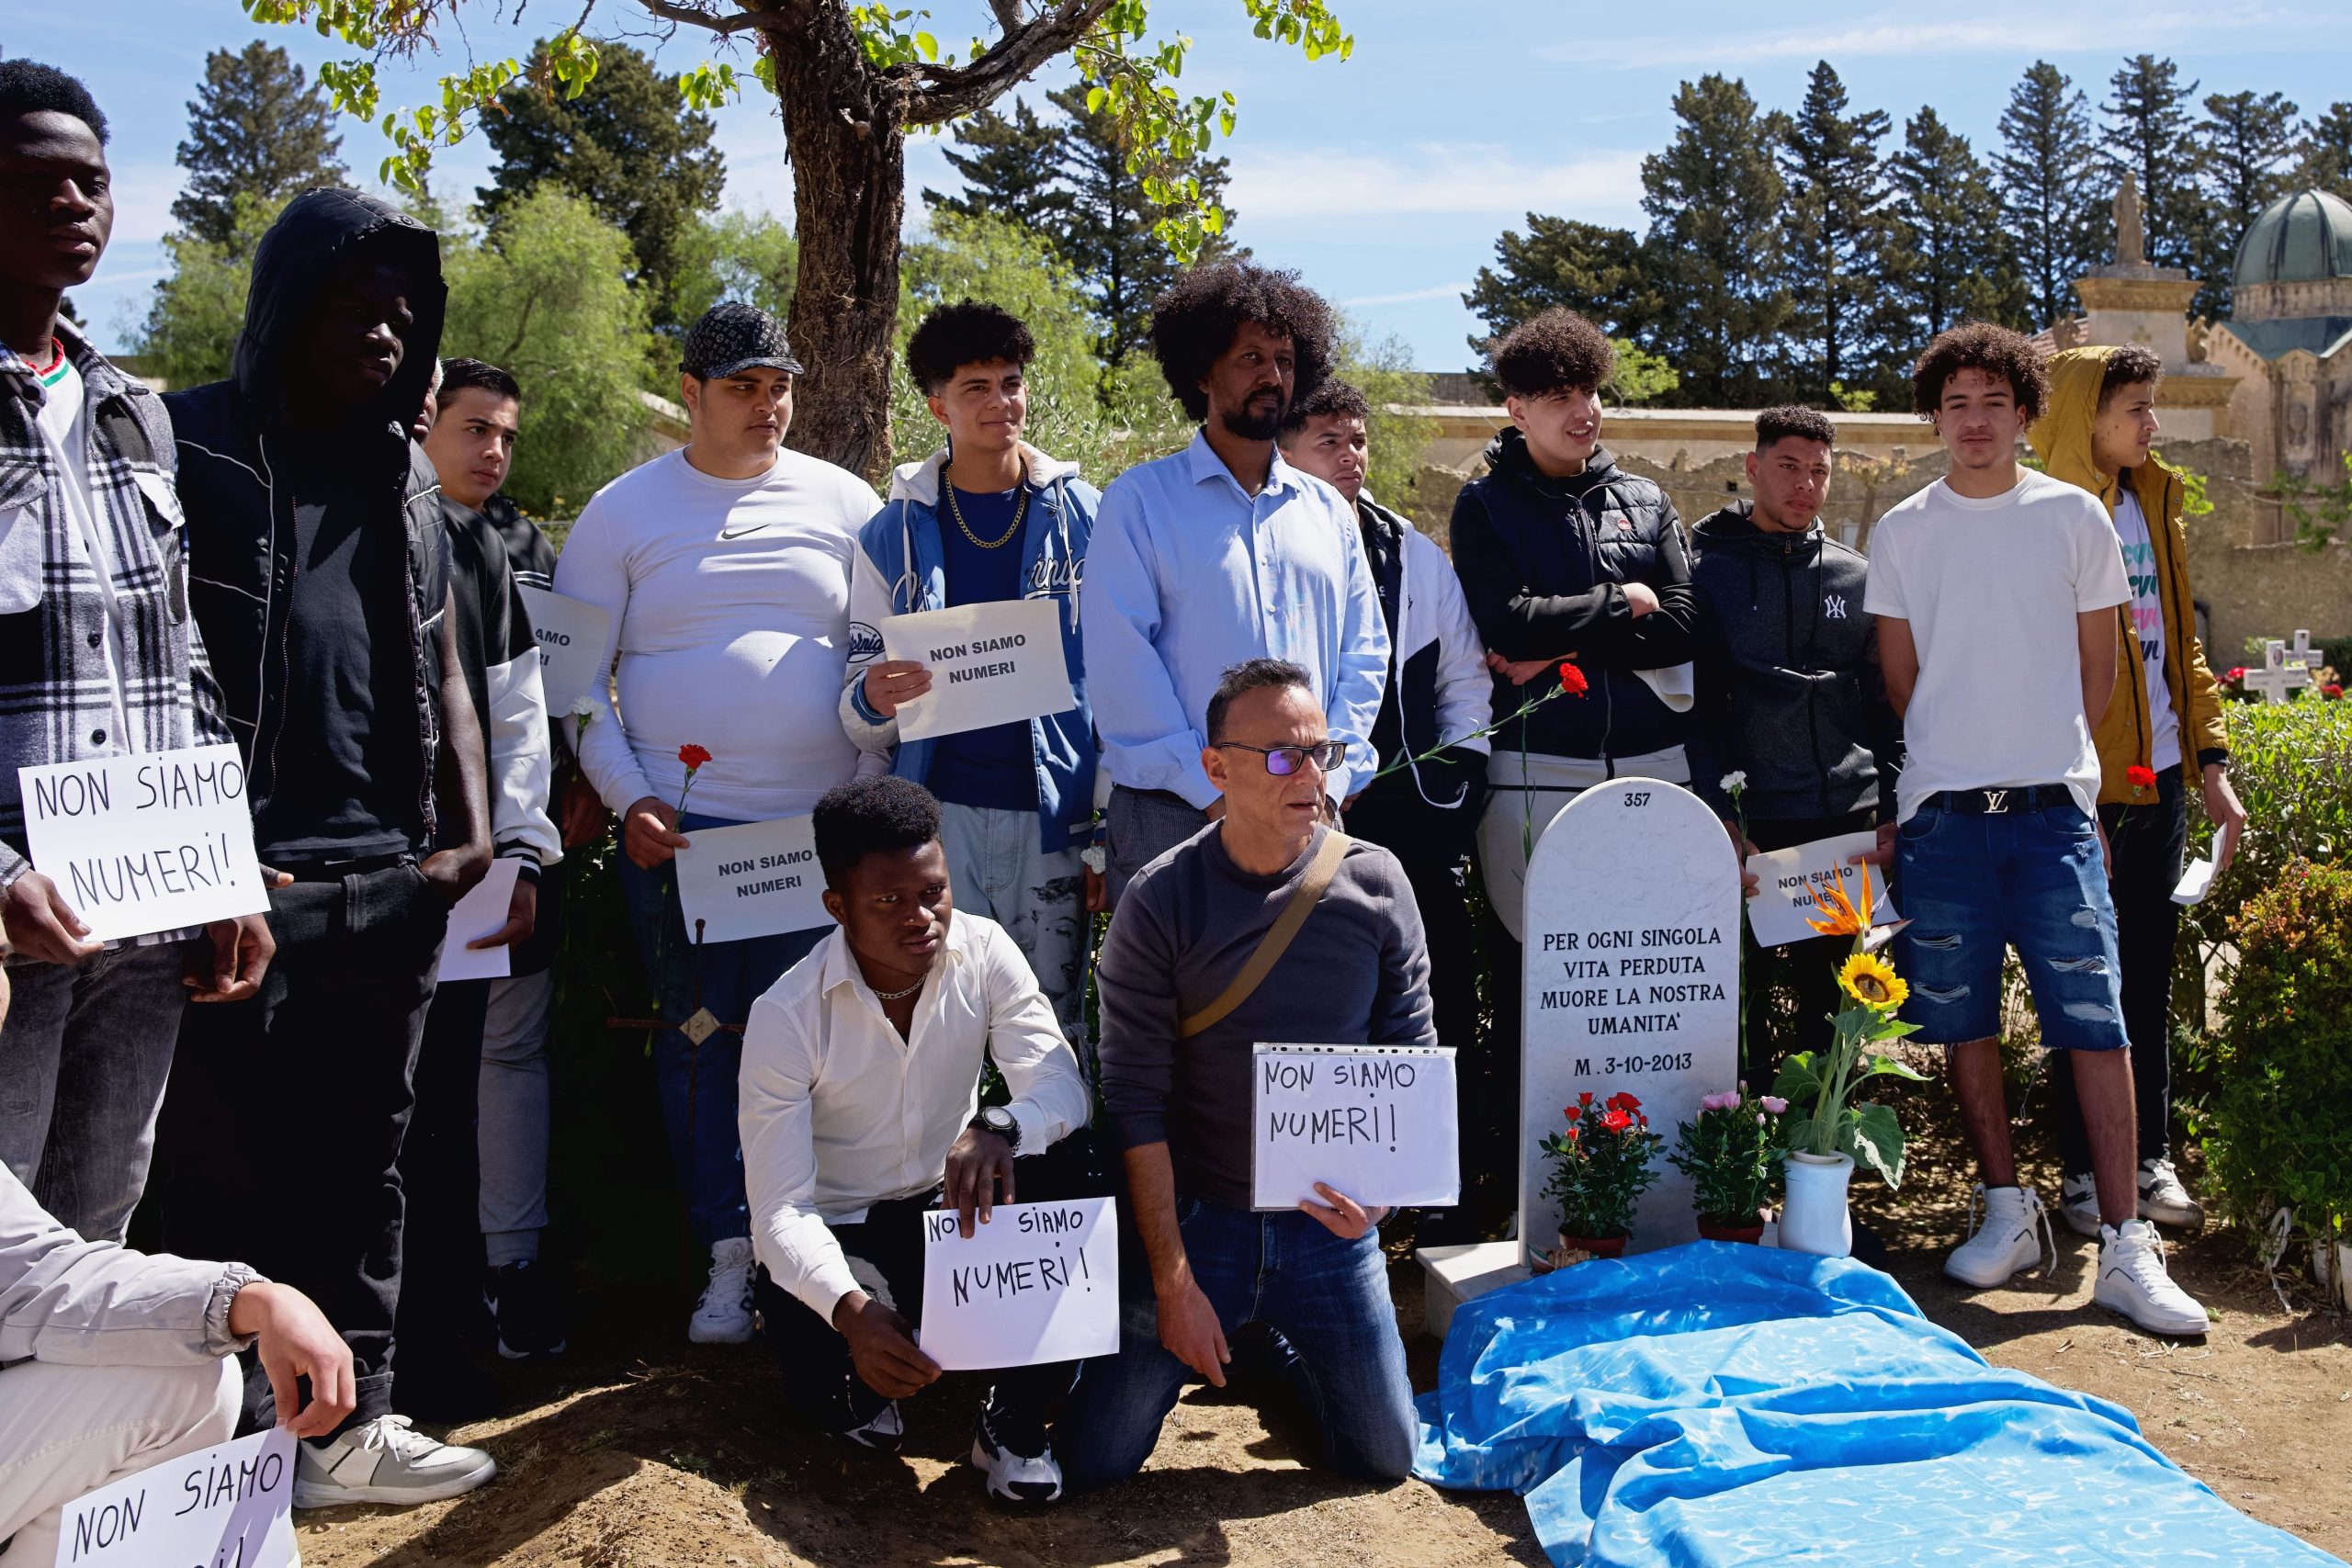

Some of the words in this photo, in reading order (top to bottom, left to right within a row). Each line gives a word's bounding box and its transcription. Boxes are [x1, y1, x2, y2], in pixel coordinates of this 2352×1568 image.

[535, 628, 571, 646] AMO
[930, 644, 967, 662] NON
[972, 634, 1026, 655] SIAMO
[948, 660, 1016, 683] NUMERI
[34, 768, 110, 820] NON
[1623, 792, 1651, 807] 357
[718, 859, 755, 877] NON
[760, 849, 813, 869] SIAMO
[736, 875, 802, 898] NUMERI
[1778, 875, 1807, 889] NON
[1792, 891, 1834, 908] NUME
[1543, 932, 1579, 952] PER
[1587, 931, 1634, 949] OGNI
[1641, 927, 1722, 947] SINGOLA
[1563, 961, 1611, 978] VITA
[1620, 955, 1706, 976] PERDUTA
[1540, 989, 1608, 1010] MUORE
[1615, 987, 1642, 1005] LA
[1649, 983, 1726, 1004] NOSTRA
[1604, 1052, 1693, 1075] 3-10-2013
[1264, 1061, 1315, 1095] NON
[72, 1488, 146, 1563] NON
